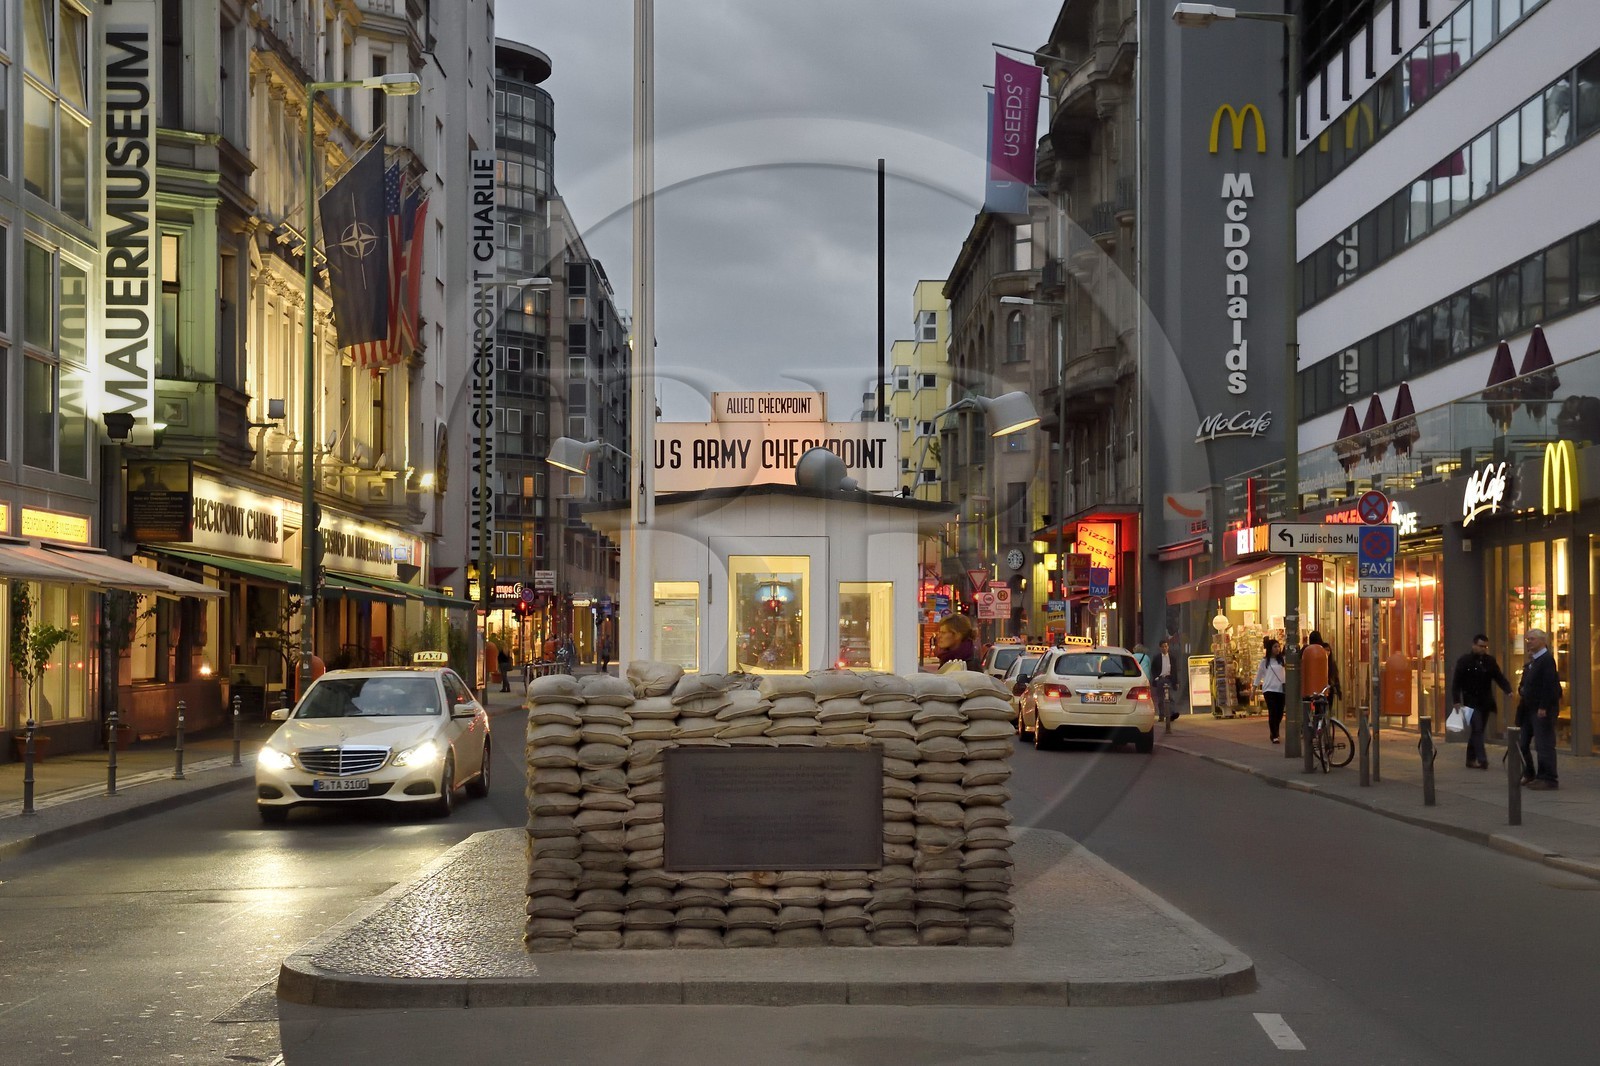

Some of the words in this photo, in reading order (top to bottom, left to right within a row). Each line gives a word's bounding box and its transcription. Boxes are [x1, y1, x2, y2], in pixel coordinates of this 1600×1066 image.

[473, 159, 494, 262] CHARLIE
[105, 32, 150, 425] MAUERMUSEUM
[473, 270, 494, 429] CHECKPOINT
[726, 397, 754, 414] ALLIED
[758, 397, 812, 414] CHECKPOINT
[693, 439, 751, 469] ARMY
[247, 509, 279, 544] CHARLIE
[1079, 526, 1115, 545] Pizza
[1299, 533, 1343, 544] Jüdisches
[1346, 534, 1359, 544] Mu
[1078, 540, 1116, 560] Pasta
[1361, 562, 1391, 574] TAXI
[1091, 586, 1107, 594] TAXI
[1363, 585, 1367, 593] 5
[1370, 584, 1390, 593] Taxen
[1066, 637, 1092, 645] TAXI
[417, 653, 443, 661] TAXI
[344, 780, 367, 789] 3100
